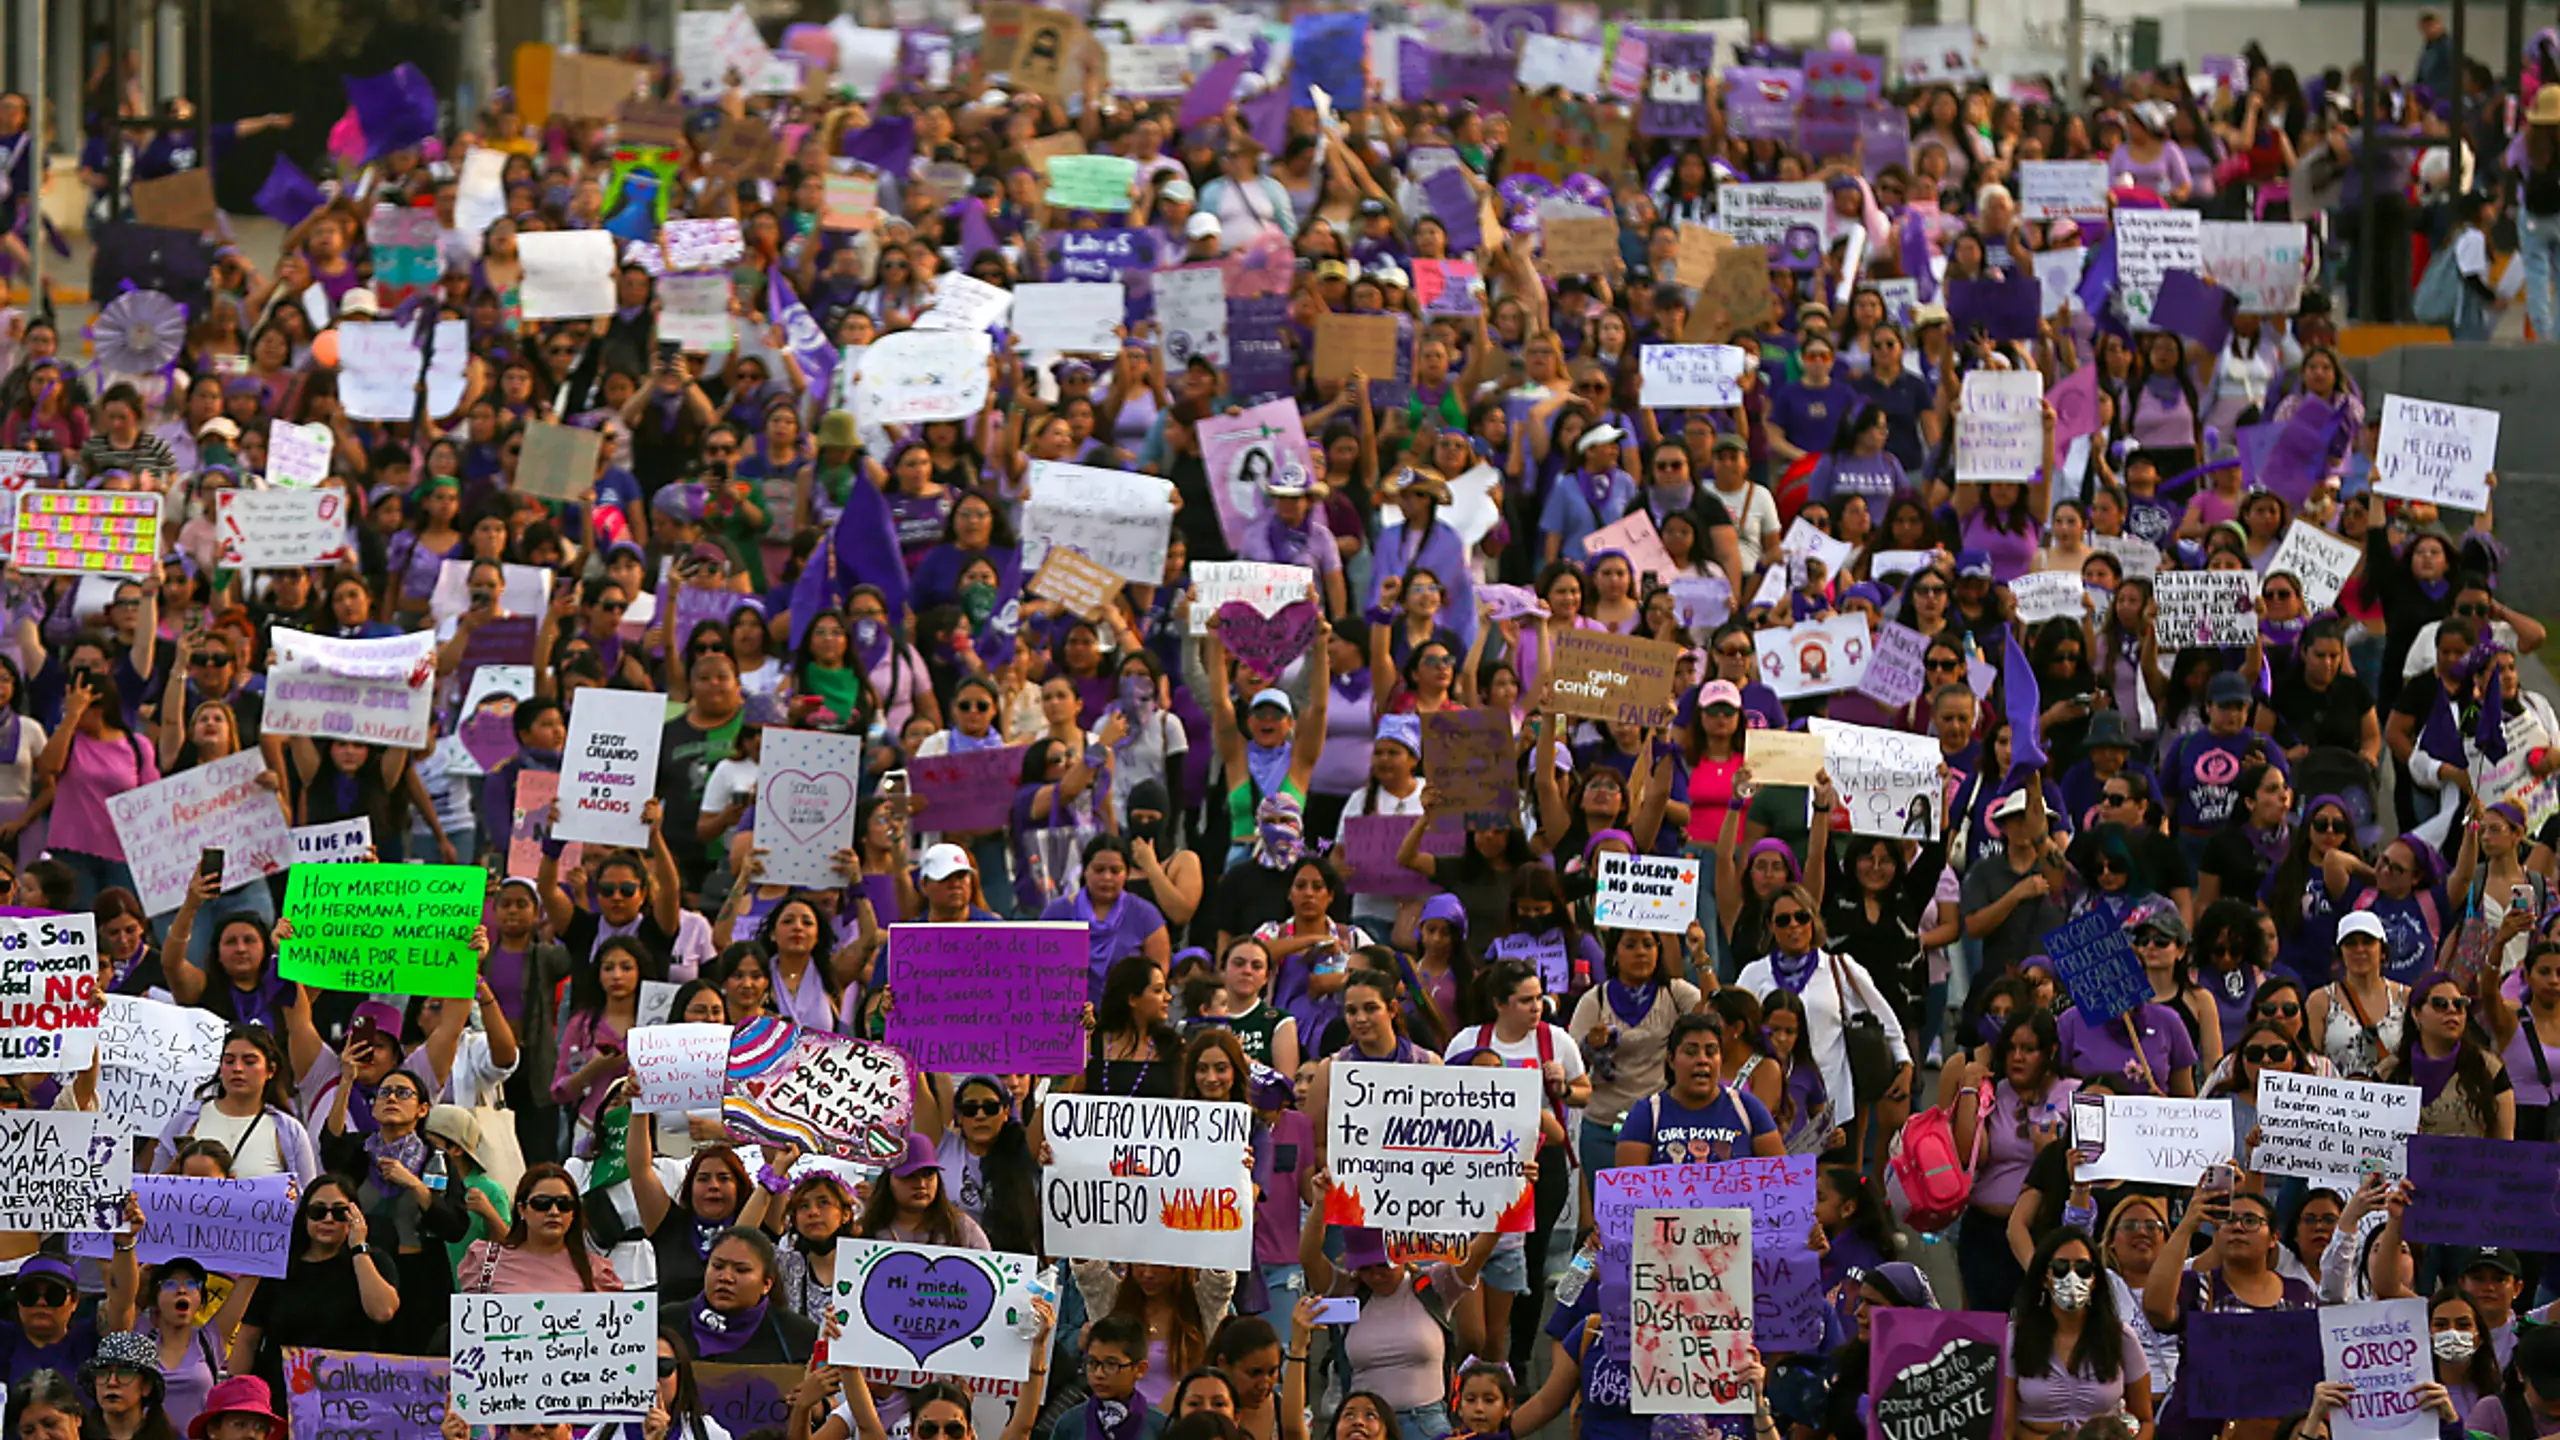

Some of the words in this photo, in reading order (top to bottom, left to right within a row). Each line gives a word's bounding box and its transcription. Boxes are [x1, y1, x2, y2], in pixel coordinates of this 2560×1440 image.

[591, 733, 627, 747] ESTOY
[590, 787, 612, 798] NO
[578, 798, 631, 814] MACHOS
[1605, 859, 1627, 876] MI
[1630, 862, 1679, 881] CUERPO
[303, 874, 343, 899] HOY
[347, 879, 421, 896] MARCHO
[427, 879, 466, 894] CON
[1608, 878, 1628, 894] NO
[291, 903, 317, 919] MI
[320, 903, 411, 919] HERMANA,
[416, 903, 479, 919] PORQUE
[41, 923, 85, 946] Son
[292, 924, 316, 940] NO
[322, 923, 384, 938] QUIERO
[393, 925, 472, 943] MARCHAR
[288, 945, 360, 966] MAÑANA
[369, 948, 400, 966] POR
[407, 947, 459, 968] ELLA
[896, 933, 932, 957] Que
[939, 934, 959, 954] los
[966, 933, 1000, 962] ojos
[1006, 932, 1030, 954] de
[1036, 934, 1062, 955] las
[5, 954, 91, 979] provocan
[45, 975, 96, 1003] NO
[340, 969, 395, 992] #8M
[1018, 987, 1031, 1002] el
[1041, 987, 1084, 1003] llanto
[913, 1014, 938, 1027] sus
[944, 1007, 1001, 1027] madres
[1011, 1012, 1035, 1027] NO
[156, 1052, 185, 1074] SE
[845, 1043, 892, 1075] Por
[812, 1047, 850, 1083] las
[862, 1082, 901, 1111] lxs
[796, 1065, 834, 1098] que
[836, 1093, 882, 1125] nos
[1344, 1069, 1376, 1108] Si
[1382, 1084, 1414, 1106] mi
[1420, 1080, 1517, 1117] protesta
[2287, 1077, 2302, 1093] la
[2381, 1093, 2407, 1109] que
[770, 1081, 867, 1140] FALTAN
[2110, 1100, 2148, 1119] Las
[1051, 1100, 1134, 1141] QUIERO
[1141, 1104, 1201, 1141] VIVIR
[1207, 1107, 1249, 1143] SIN
[1337, 1113, 1369, 1146] te
[2359, 1126, 2387, 1139] pero
[1689, 1126, 1737, 1144] POWER
[2318, 1136, 2335, 1152] de
[71, 1156, 104, 1179] DE
[1113, 1144, 1181, 1177] MIEDO
[1337, 1156, 1414, 1184] imagina
[1421, 1155, 1457, 1186] qué
[1465, 1150, 1527, 1180] siento
[1677, 1157, 1788, 1184] CHIKITA
[2263, 1152, 2286, 1167] que
[16, 1177, 93, 1198] HOMBRE
[1652, 1184, 1673, 1199] VA
[1683, 1184, 1698, 1197] A
[150, 1192, 183, 1214] UN
[188, 1197, 243, 1225] GOL,
[251, 1198, 292, 1227] QUE
[1049, 1178, 1148, 1229] QUIERO
[1160, 1187, 1239, 1230] VIVIR
[1373, 1189, 1401, 1217] Yo
[1407, 1198, 1446, 1226] por
[1455, 1190, 1485, 1219] tu
[8, 1212, 34, 1231] TU
[40, 1212, 88, 1231] HIJA
[1654, 1216, 1686, 1247] Tu
[1692, 1223, 1743, 1248] amor
[887, 1274, 909, 1291] Mi
[916, 1279, 969, 1297] miedo
[1635, 1261, 1724, 1293] Estaba
[541, 1309, 582, 1338] qué
[595, 1300, 634, 1339] algo
[893, 1315, 961, 1334] FUERZA
[1633, 1298, 1753, 1334] Disfrazado
[2331, 1327, 2350, 1342] TE
[2398, 1319, 2413, 1334] DE
[501, 1345, 533, 1364] tan
[610, 1343, 646, 1357] como
[1681, 1335, 1714, 1358] DE
[2341, 1338, 2418, 1370] OIRLO?
[312, 1354, 410, 1394] Calladita
[541, 1371, 553, 1387] a
[560, 1370, 592, 1386] casa
[599, 1367, 619, 1385] se
[1632, 1362, 1755, 1402] Violencia
[320, 1399, 371, 1422] me
[479, 1391, 527, 1416] siente
[535, 1394, 572, 1410] como
[1881, 1386, 1993, 1440] VIOLASTE
